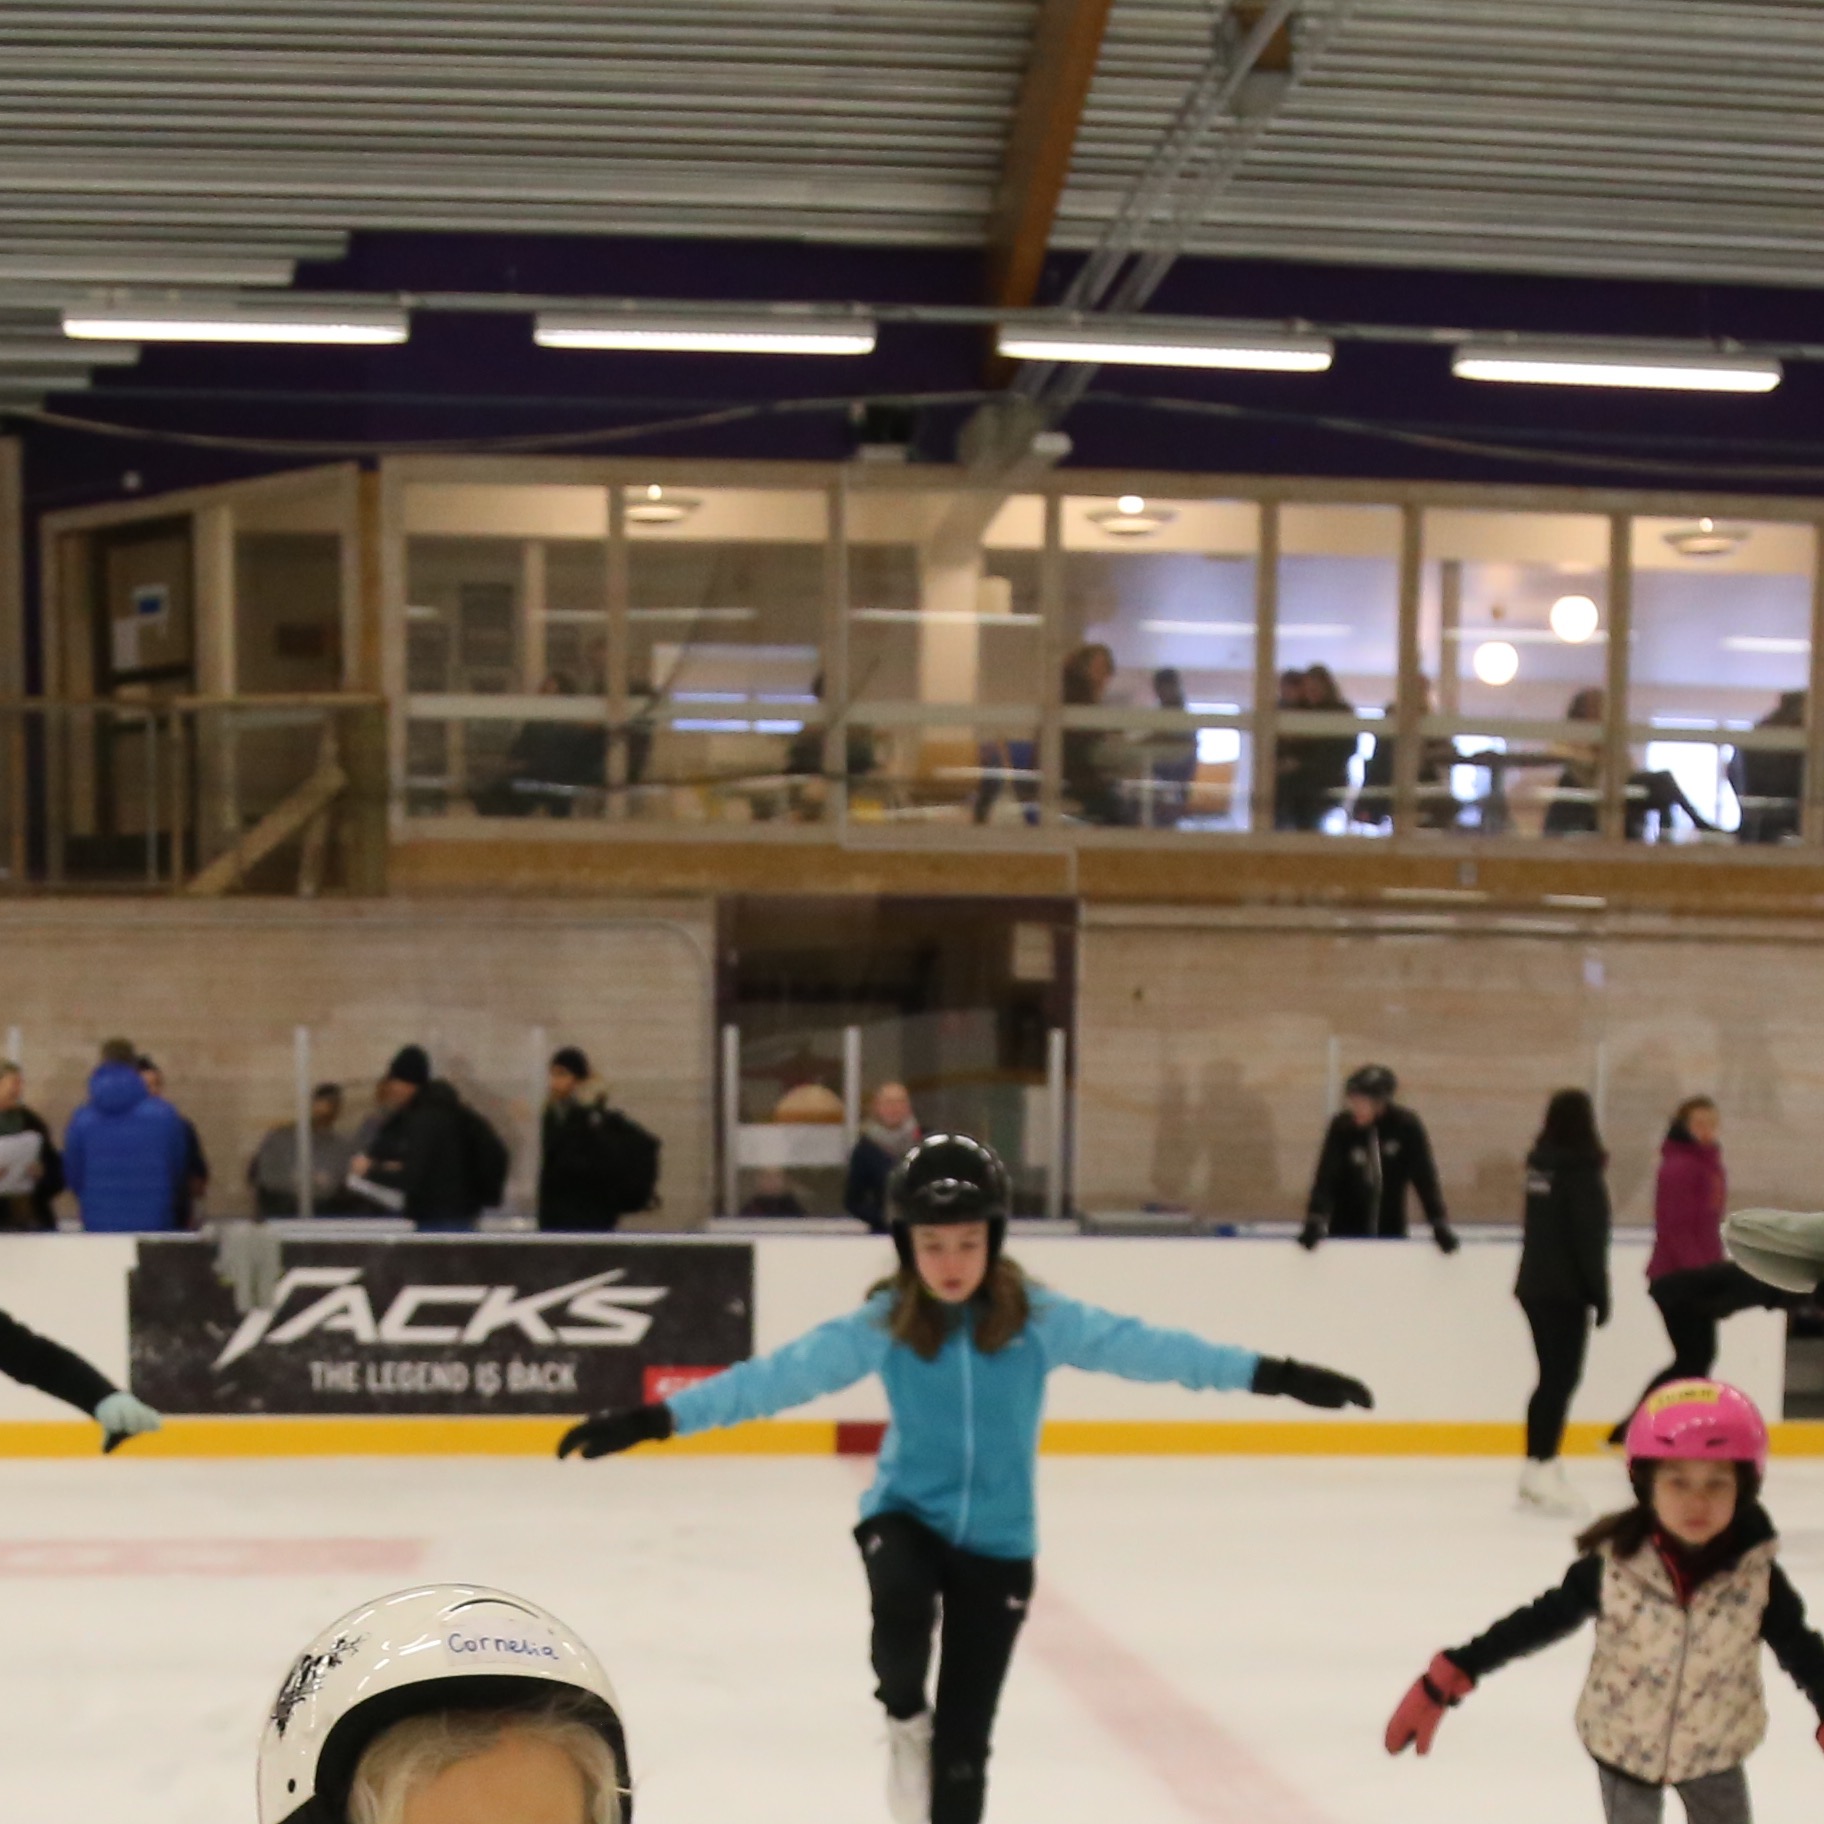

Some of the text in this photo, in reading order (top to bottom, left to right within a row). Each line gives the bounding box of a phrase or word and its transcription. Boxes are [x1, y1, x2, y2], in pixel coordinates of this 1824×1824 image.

[308, 1359, 576, 1394] THE LEGEND IS BACK
